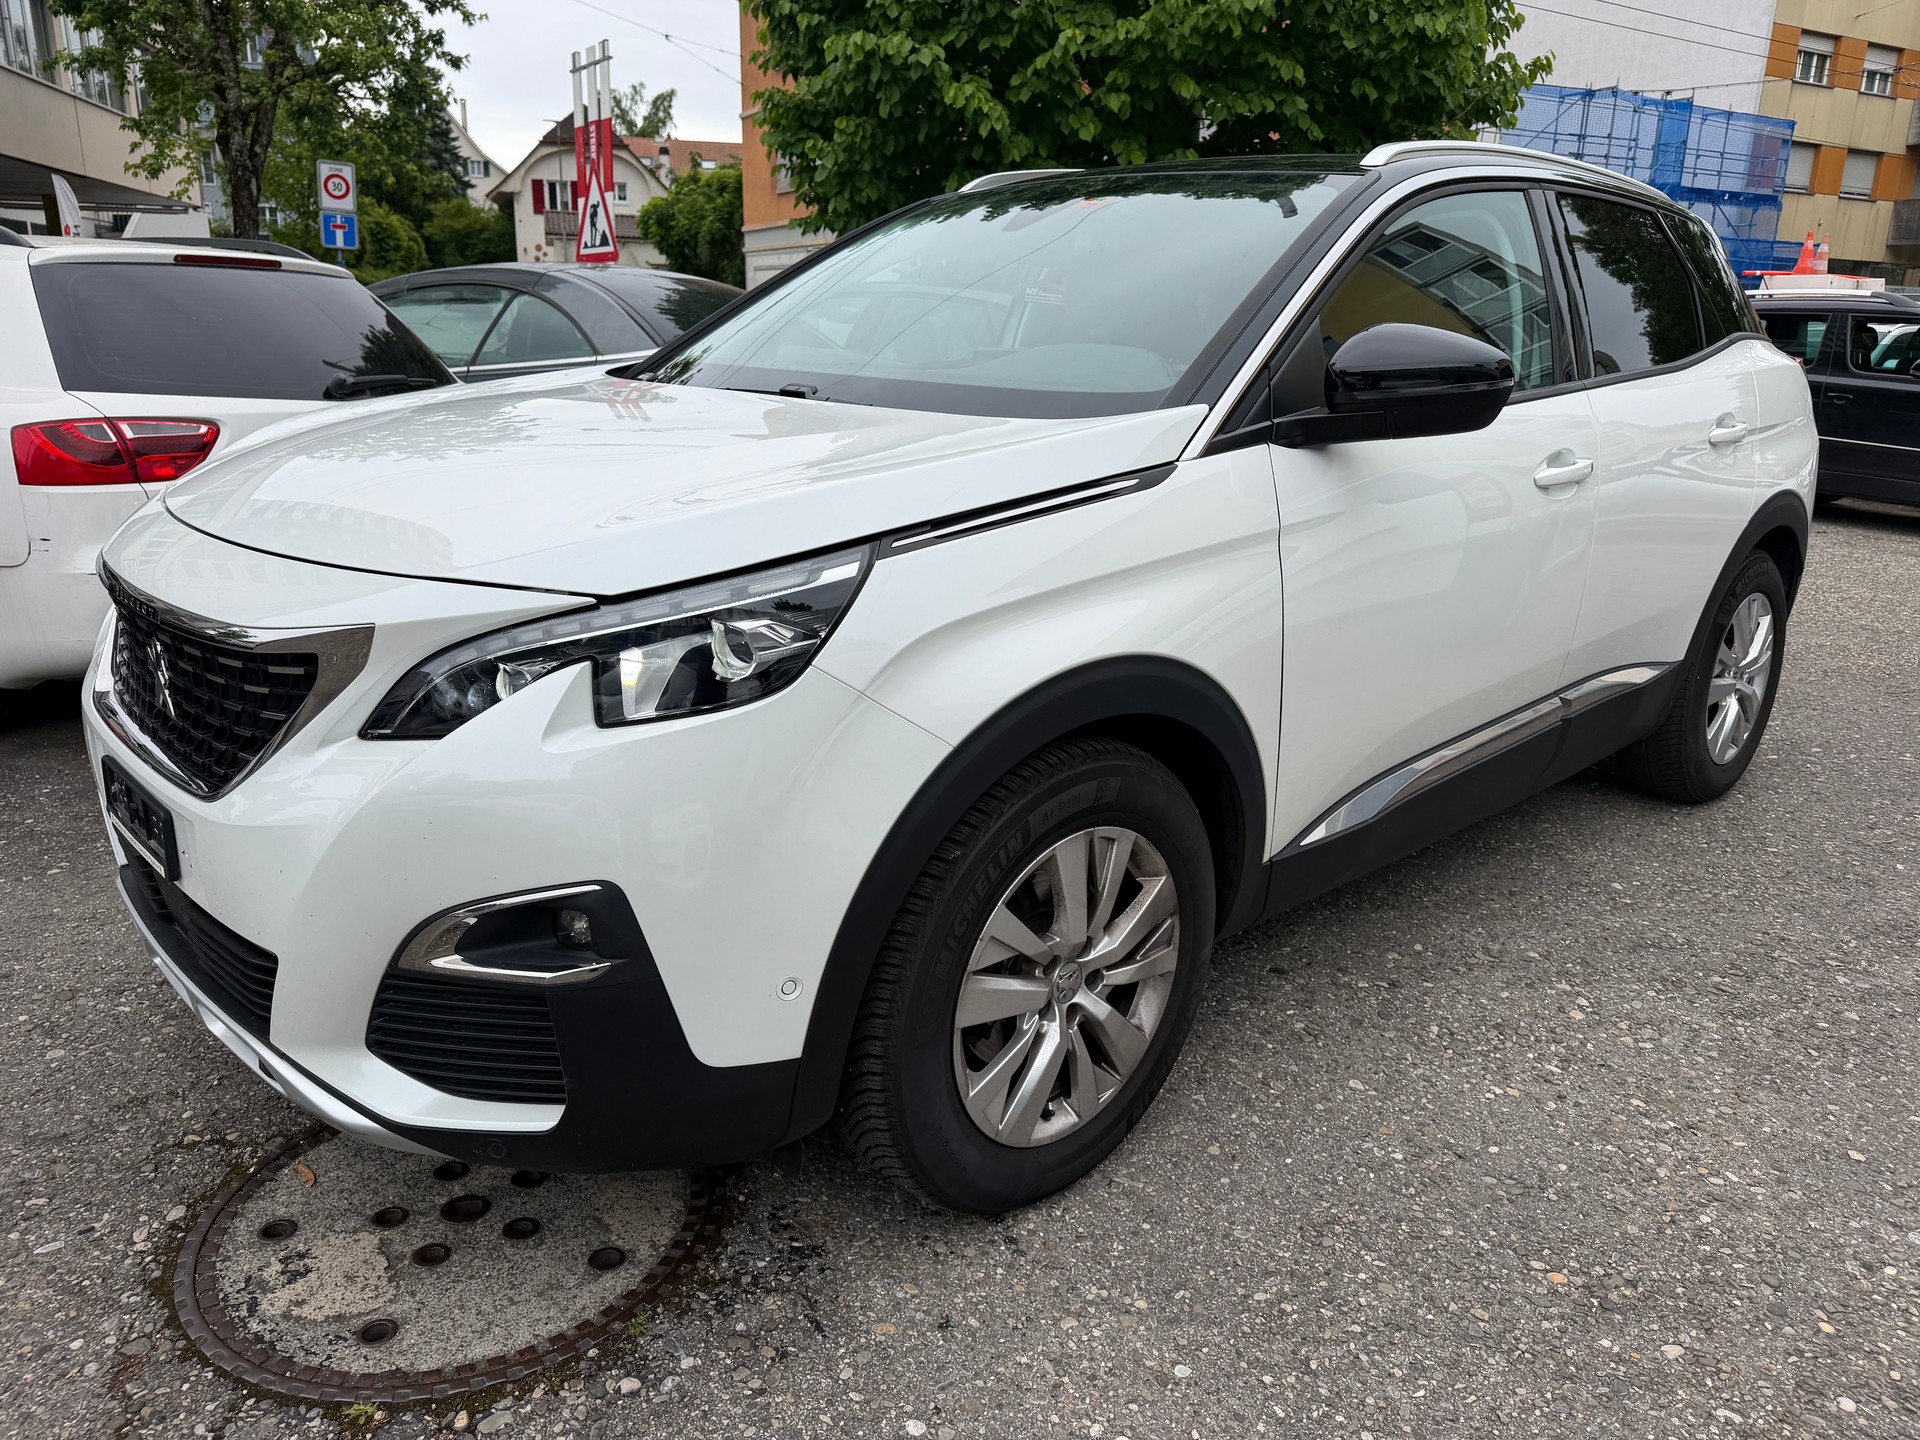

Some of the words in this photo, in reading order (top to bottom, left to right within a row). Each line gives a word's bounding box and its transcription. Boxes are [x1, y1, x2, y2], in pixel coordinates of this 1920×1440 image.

[331, 181, 343, 192] 30
[1735, 562, 1768, 598] MICHELIN
[1042, 793, 1081, 825] ALPIN
[935, 829, 1024, 980] MICHELIN
